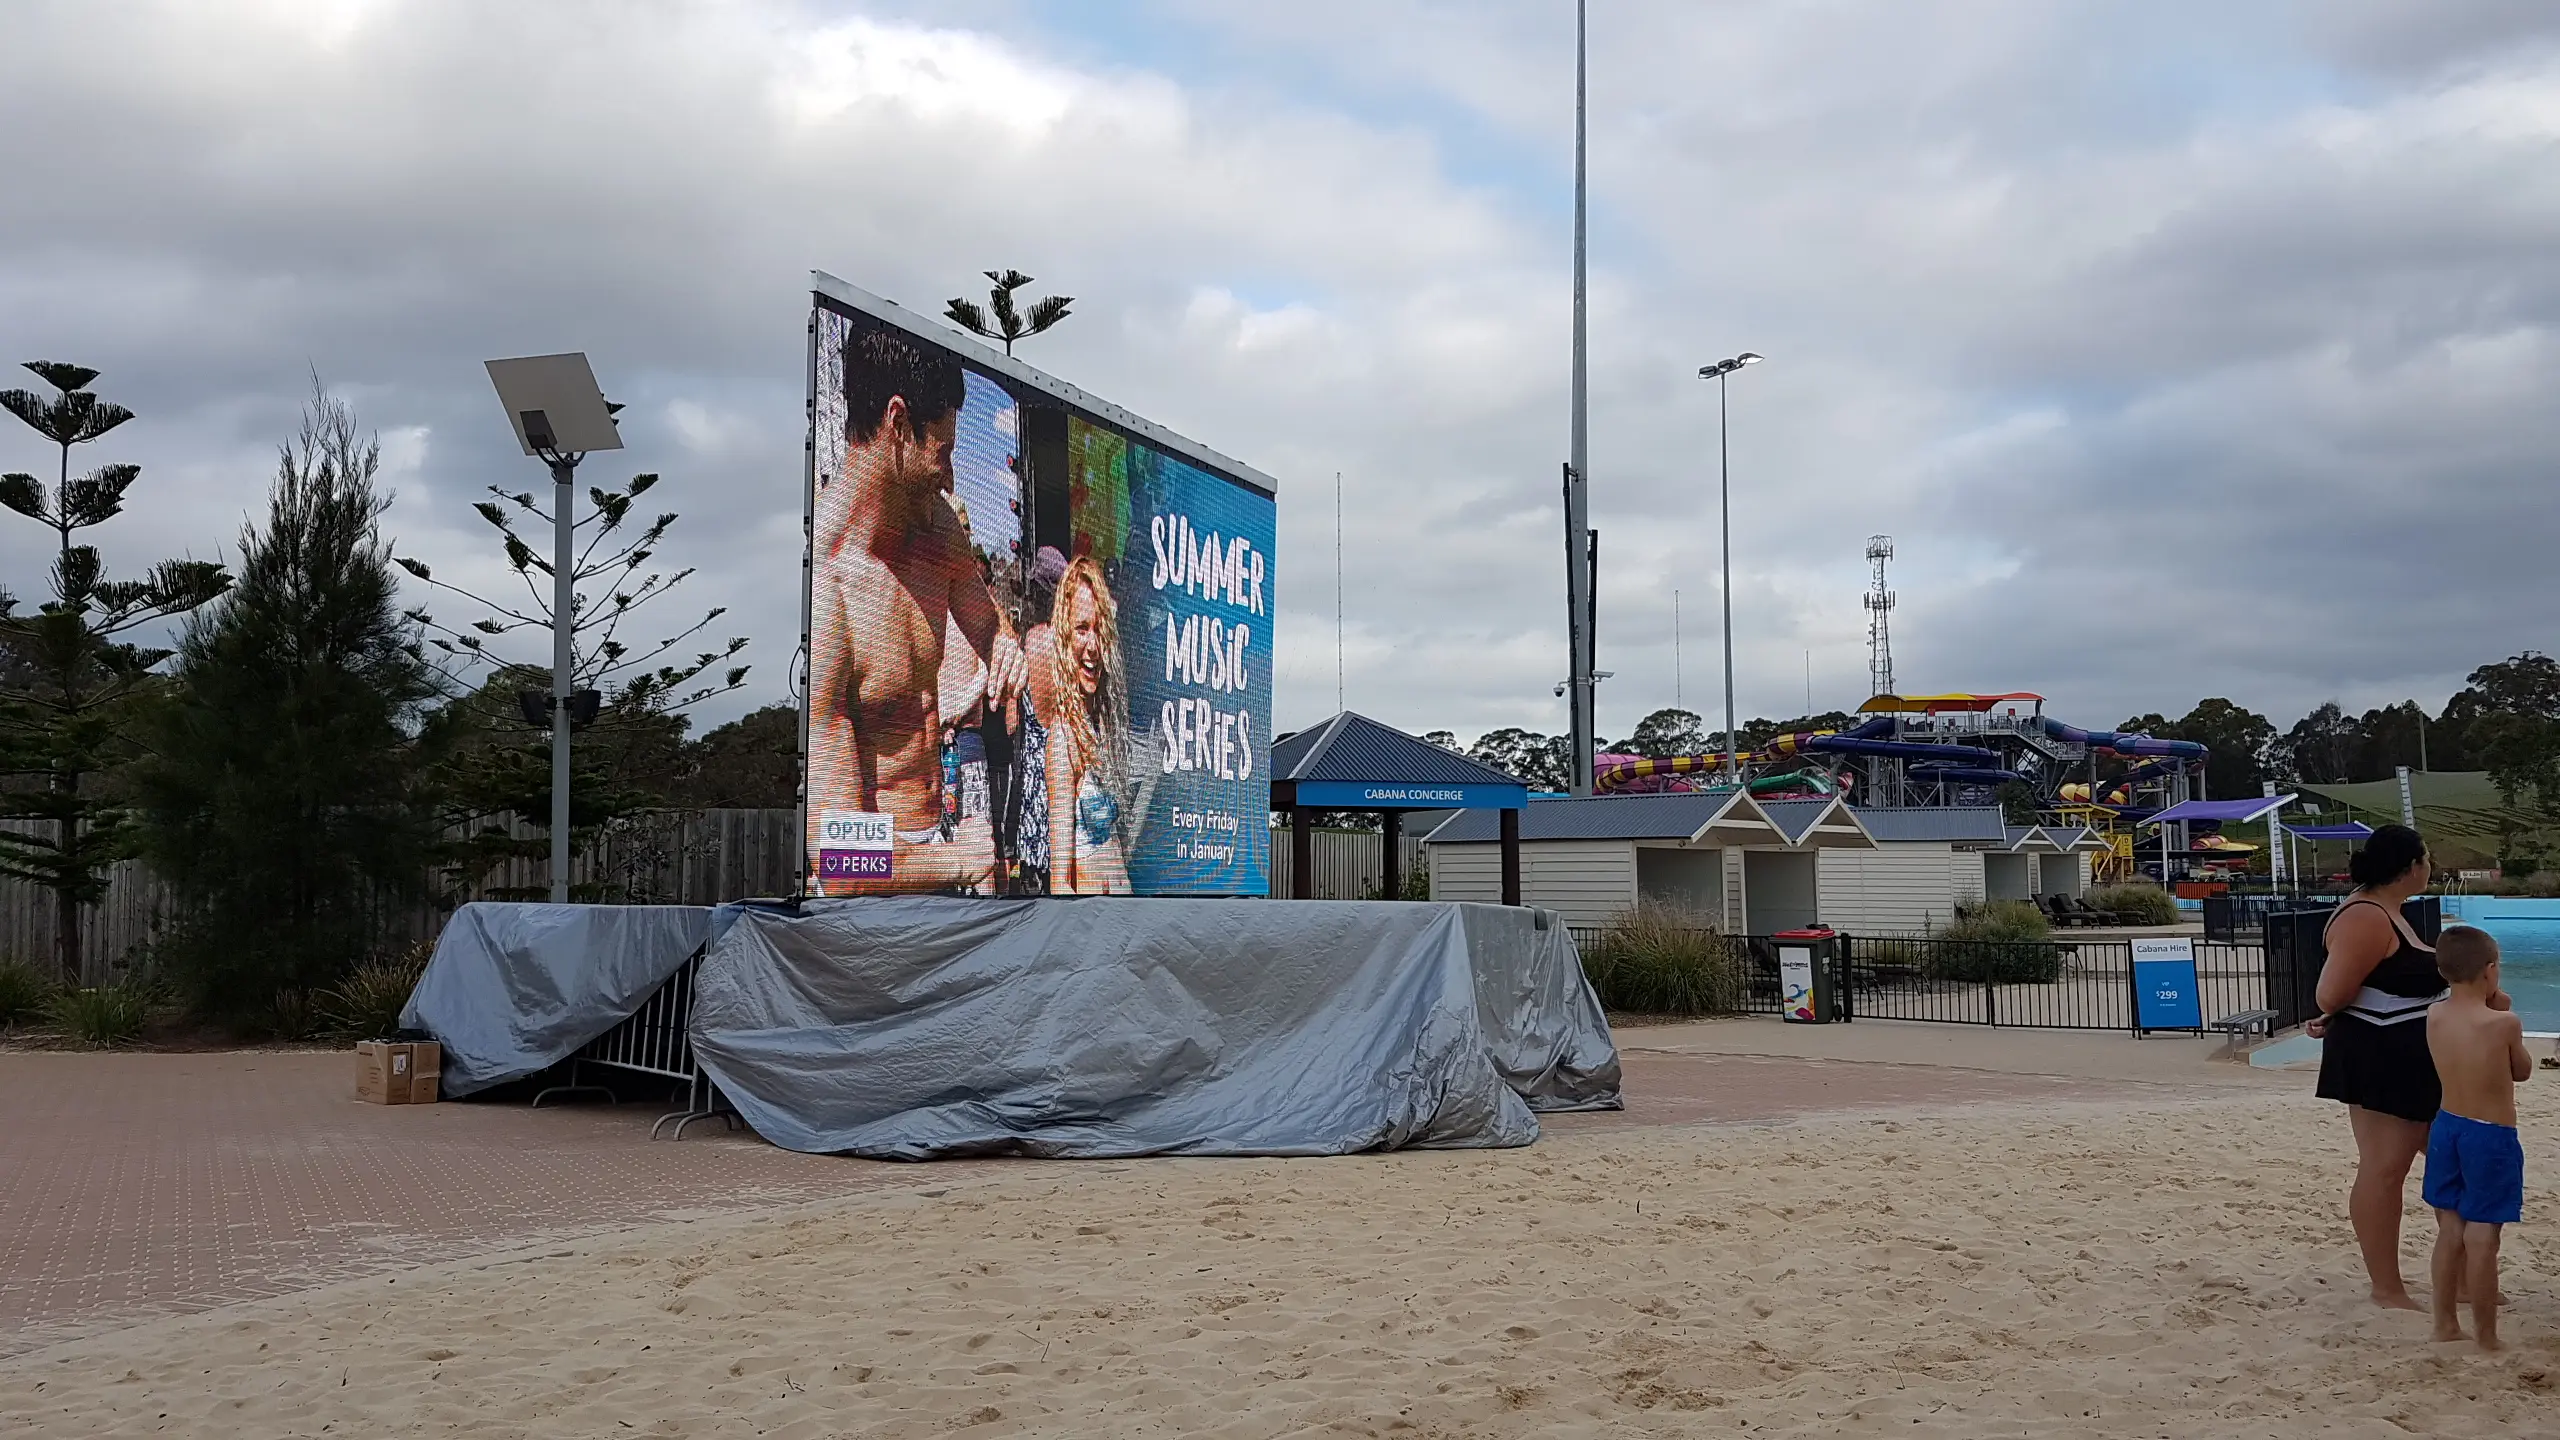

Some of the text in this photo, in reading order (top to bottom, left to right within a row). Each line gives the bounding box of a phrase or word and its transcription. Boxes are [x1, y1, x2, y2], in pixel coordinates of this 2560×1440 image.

[1151, 513, 1264, 617] SUMMER
[1364, 788, 1464, 801] CABANA CONCIERGE
[1172, 806, 1239, 836] Every Friday
[828, 820, 886, 841] OPTUS
[1177, 838, 1235, 866] in January
[842, 856, 888, 872] PERKS
[2136, 944, 2188, 953] Cabana Hire
[2155, 990, 2178, 1000] $299
